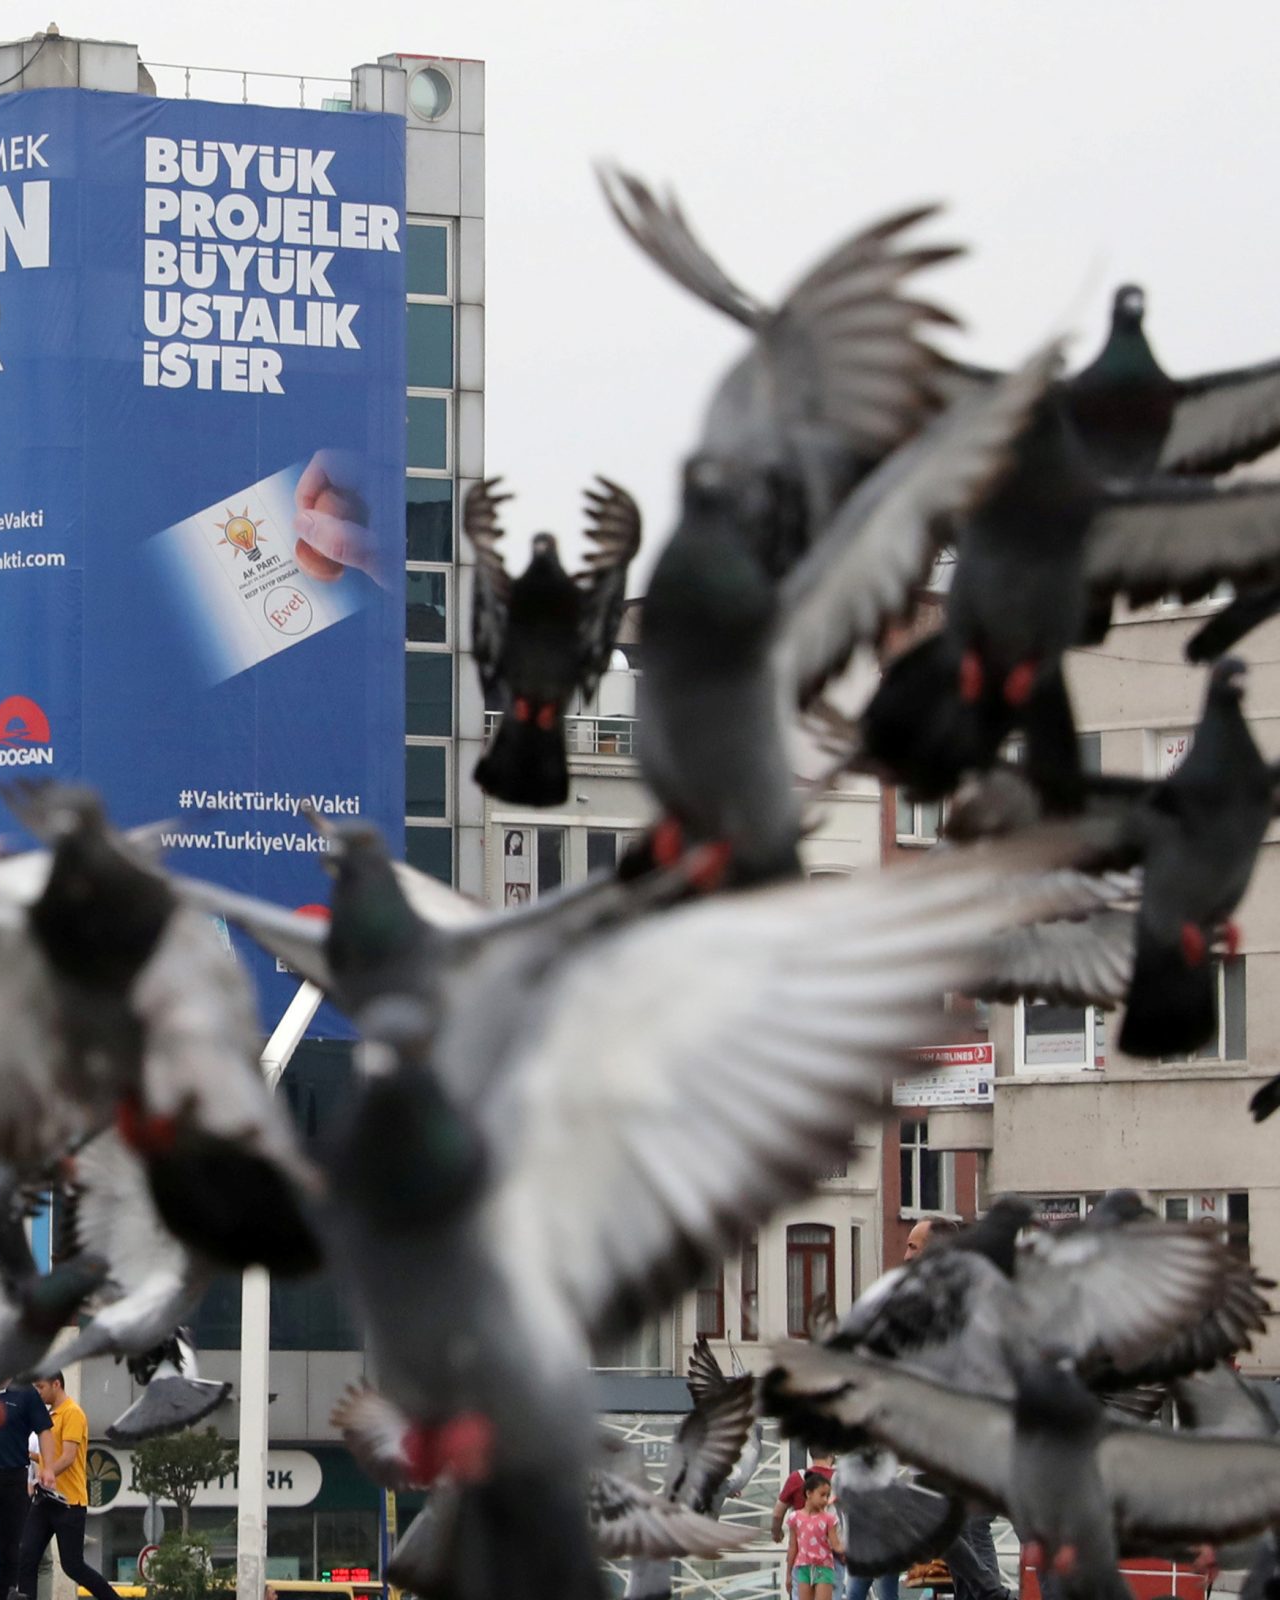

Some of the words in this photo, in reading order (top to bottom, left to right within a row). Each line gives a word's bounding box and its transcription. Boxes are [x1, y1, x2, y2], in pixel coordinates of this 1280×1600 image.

[145, 136, 337, 197] BÜYÜK
[145, 187, 401, 253] PROJELER
[144, 239, 336, 298] BÜYÜK
[143, 290, 362, 350] USTALIK
[243, 567, 255, 580] AK
[270, 592, 306, 628] Evet
[179, 789, 360, 817] #VakitTürkiyeVakti
